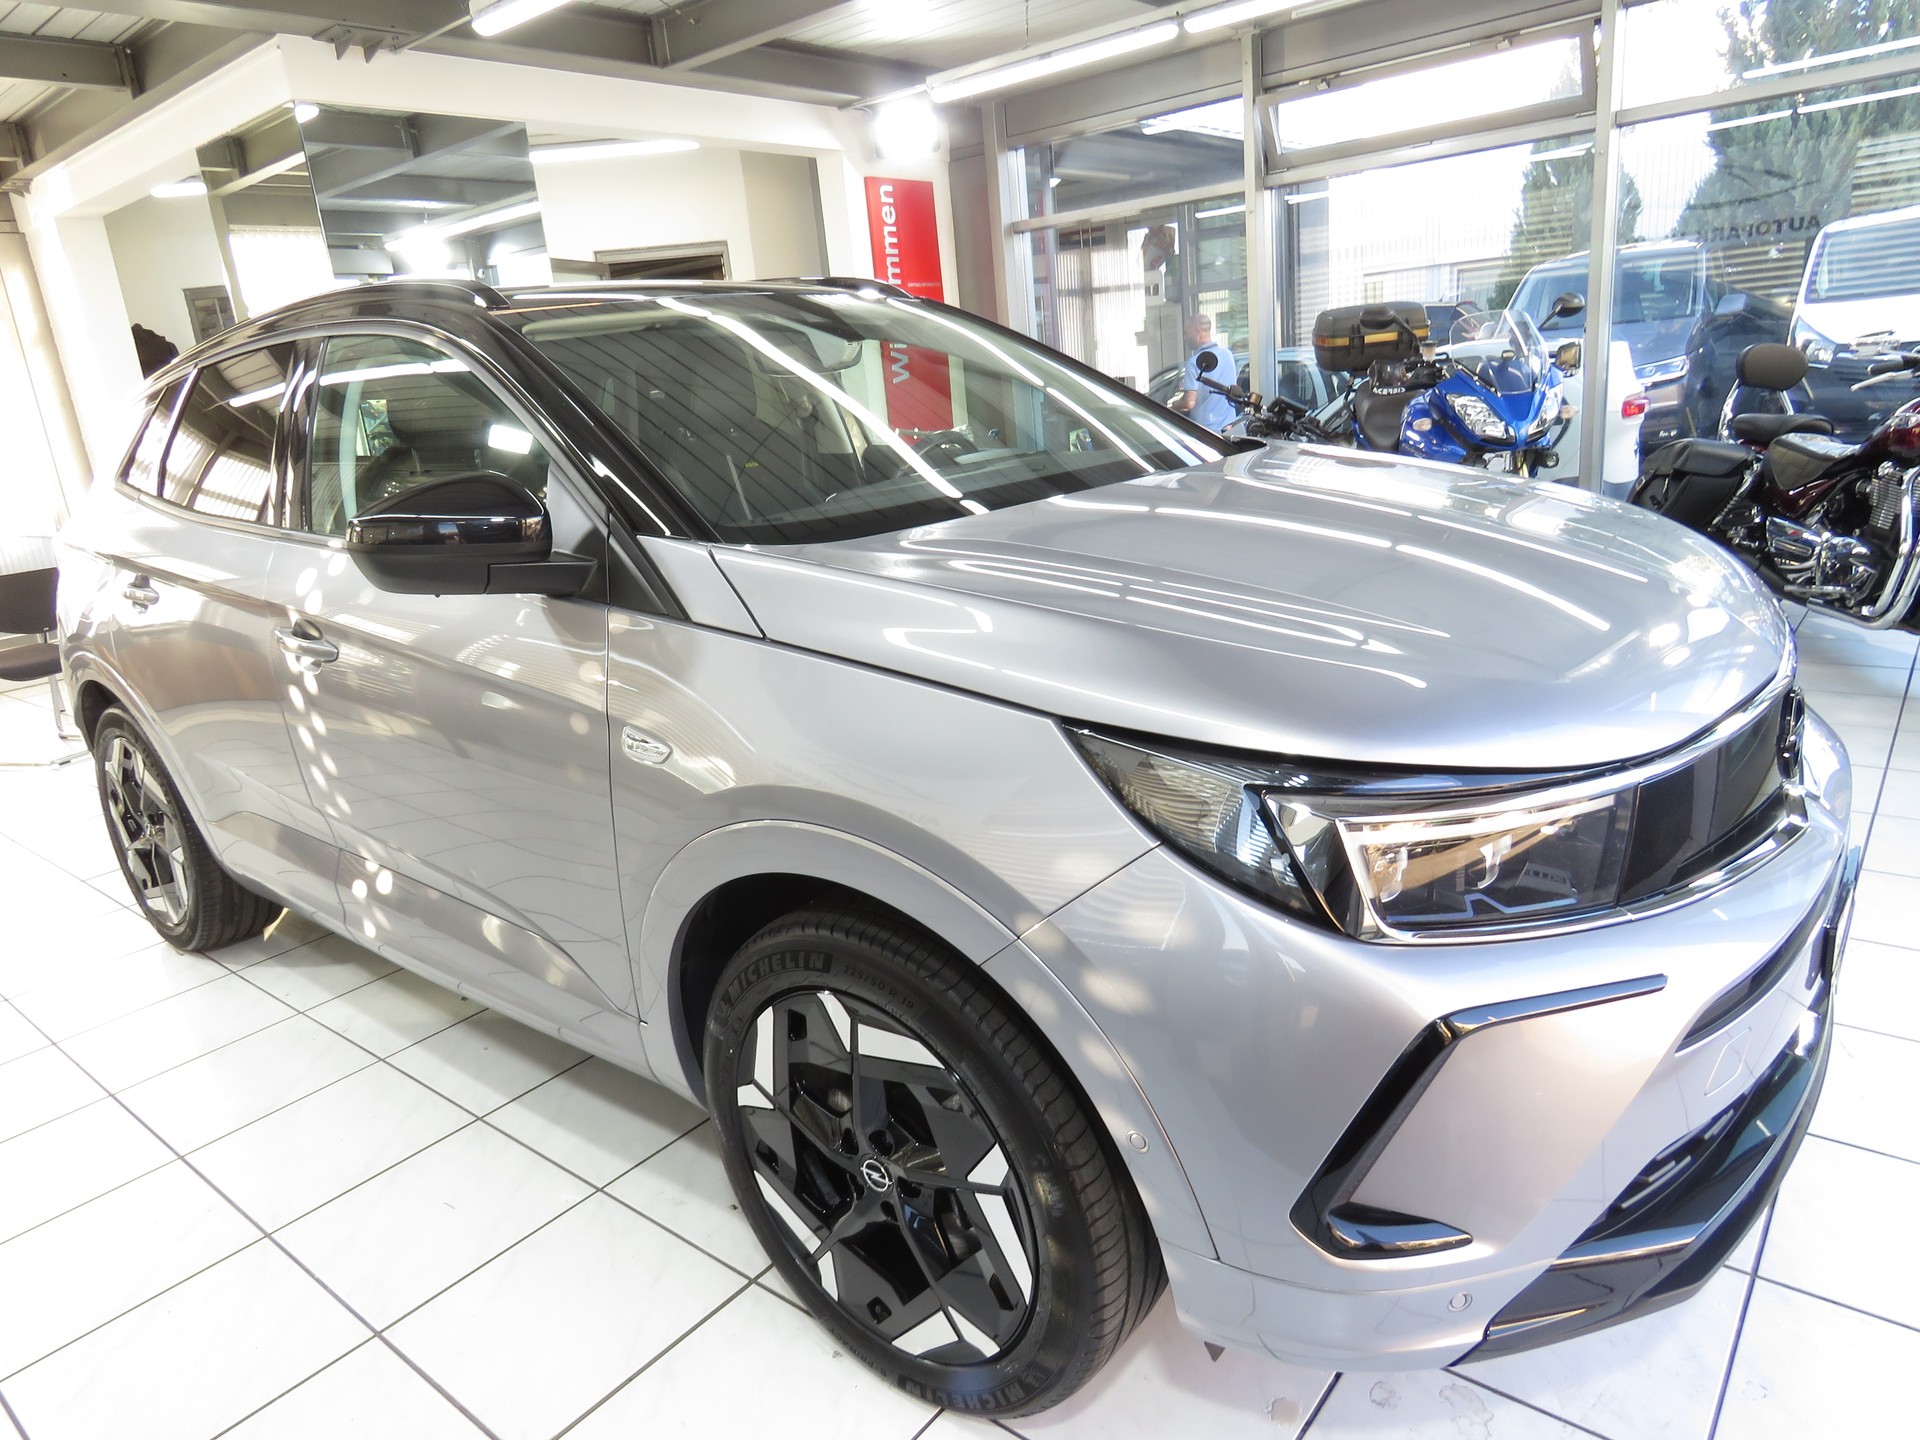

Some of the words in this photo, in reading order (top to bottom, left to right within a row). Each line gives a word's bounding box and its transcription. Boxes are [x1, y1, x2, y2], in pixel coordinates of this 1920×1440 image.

[728, 952, 825, 1003] MICHELIN
[843, 965, 886, 991] 225/50
[888, 988, 898, 999] R
[901, 996, 915, 1010] 19
[904, 1378, 1025, 1410] MICHELIN
